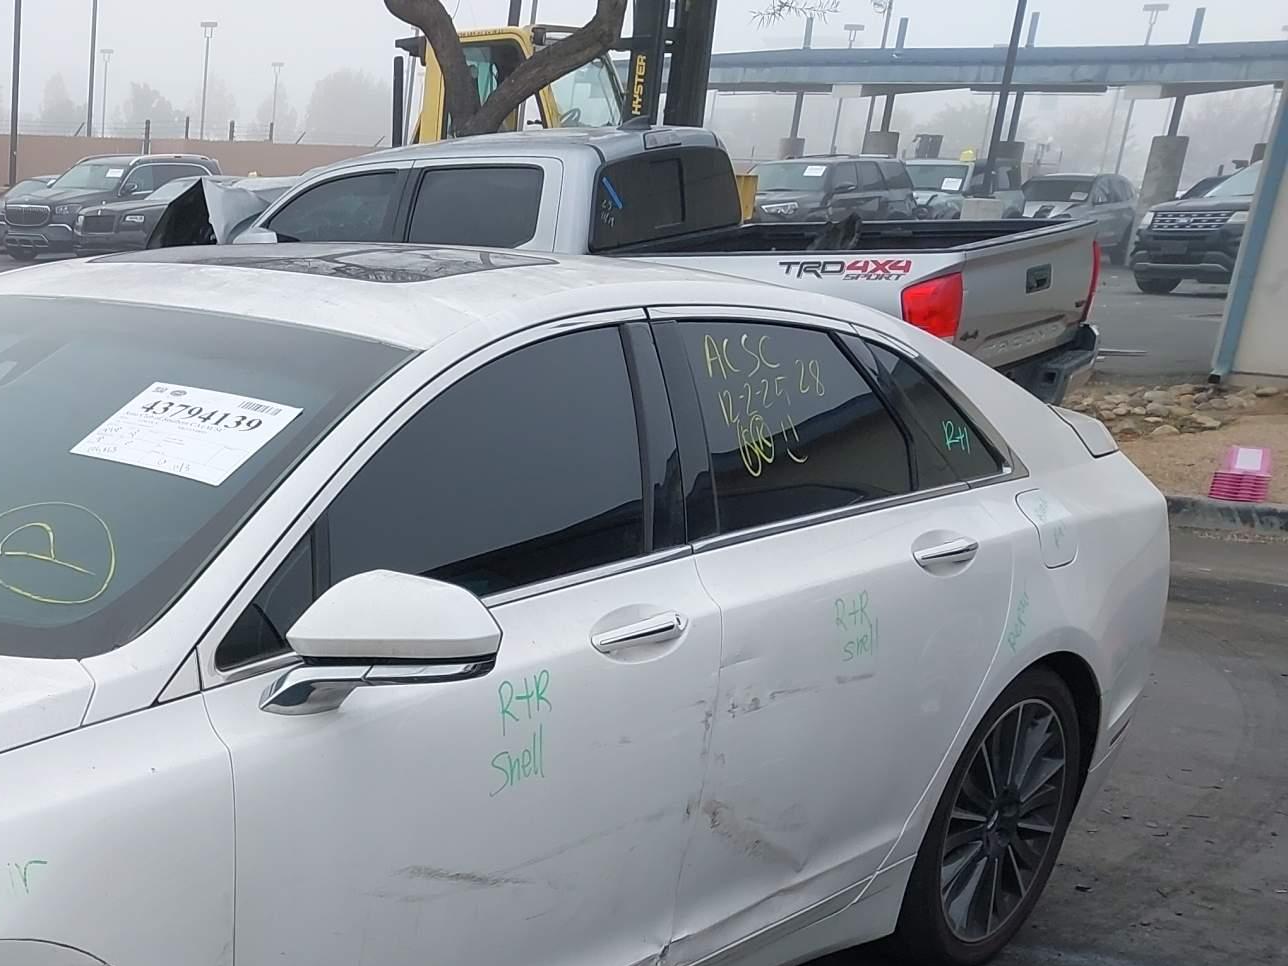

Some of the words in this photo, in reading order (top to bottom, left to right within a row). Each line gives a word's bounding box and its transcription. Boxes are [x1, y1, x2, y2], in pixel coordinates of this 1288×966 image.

[632, 55, 646, 115] HYSTER
[779, 260, 845, 279] TRD
[704, 333, 781, 380] ACSC
[794, 359, 825, 397] 28
[140, 399, 263, 432] 43794139
